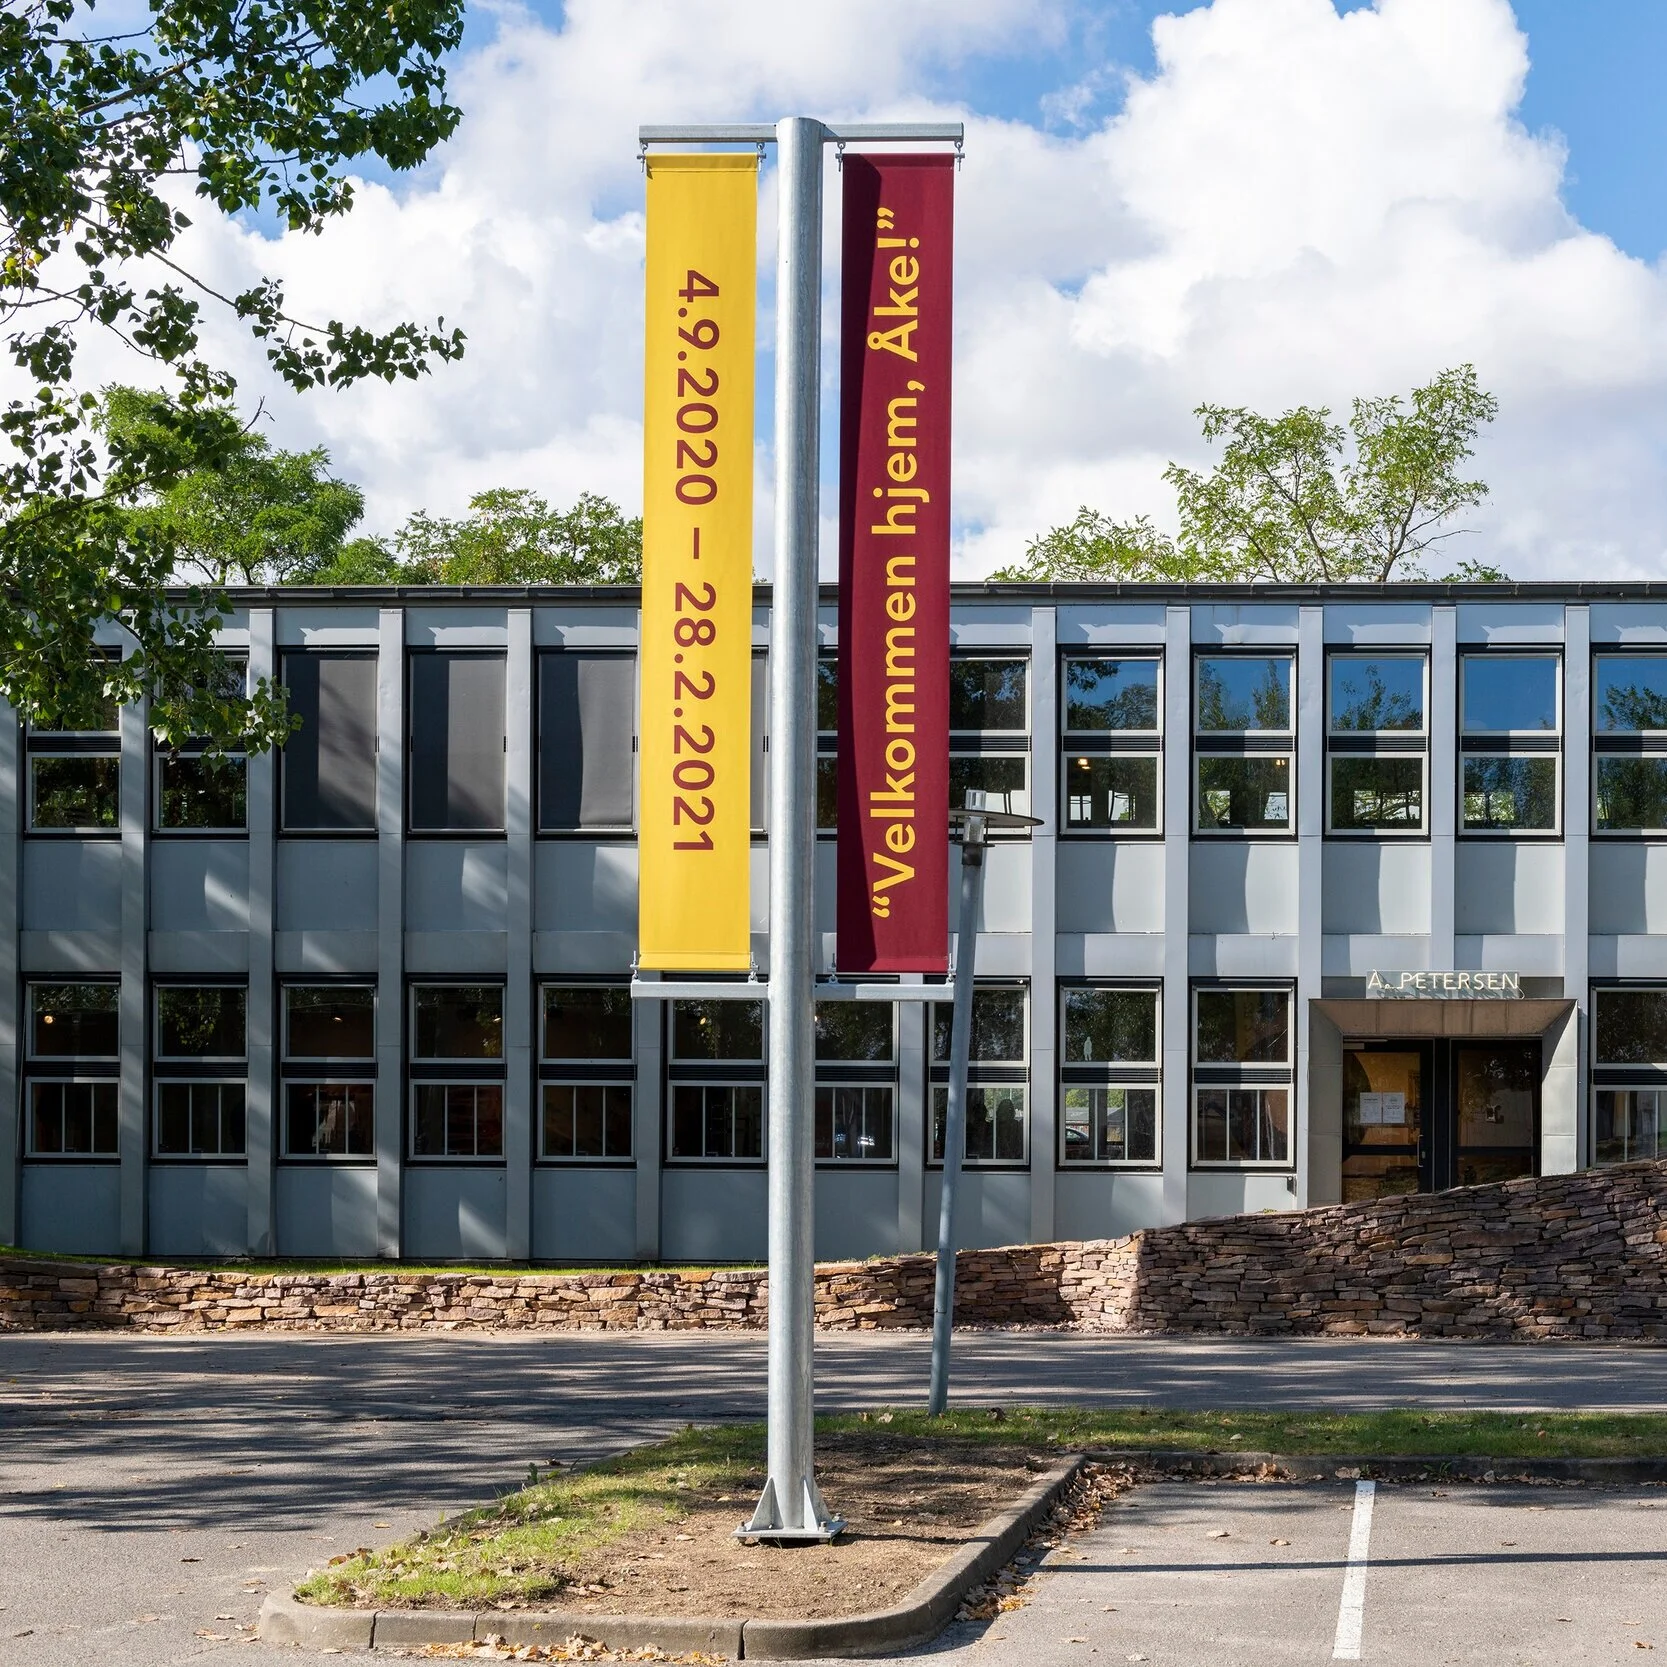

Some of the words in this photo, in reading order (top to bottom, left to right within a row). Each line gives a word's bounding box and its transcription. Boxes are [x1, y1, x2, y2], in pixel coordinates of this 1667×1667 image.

[866, 207, 920, 363] Åke!”
[675, 269, 720, 506] 4.9.2020
[871, 380, 930, 535] hjem,
[672, 581, 717, 851] 28.2.2021
[869, 556, 917, 918] “Velkommen
[1368, 972, 1390, 990] A.
[1401, 972, 1519, 990] PETERSEN
